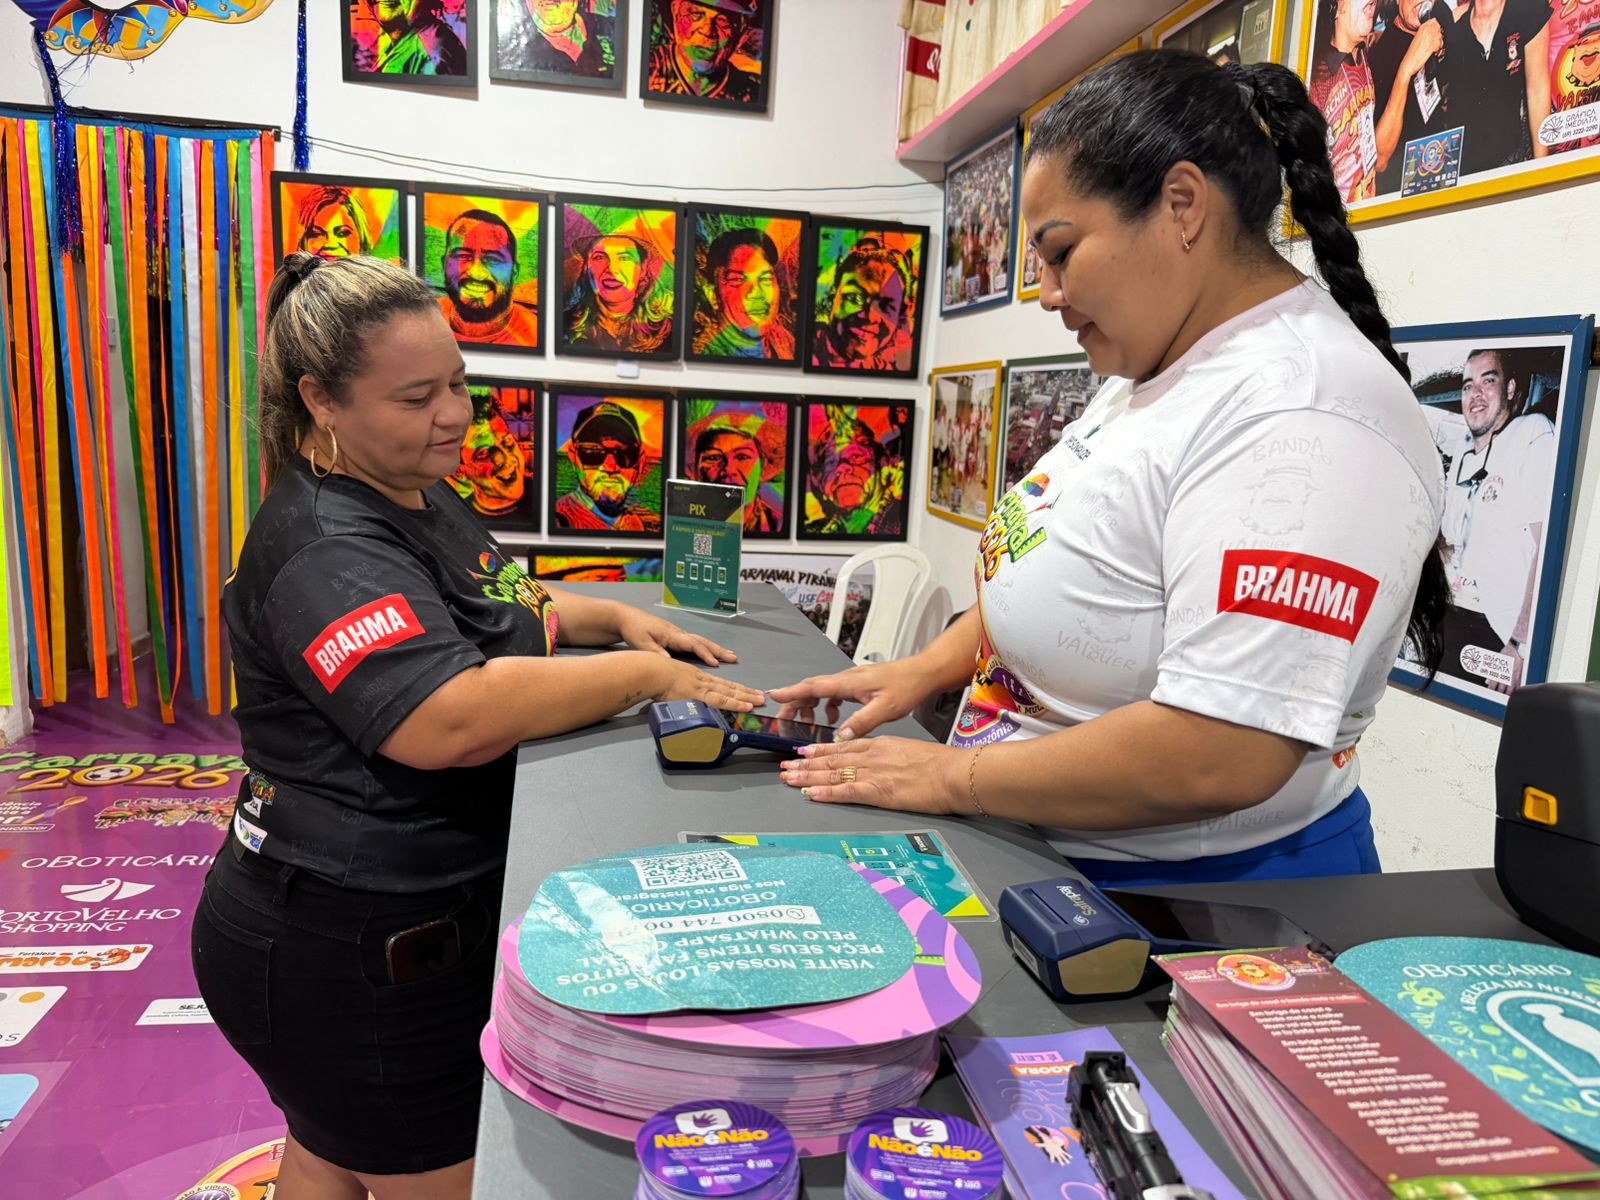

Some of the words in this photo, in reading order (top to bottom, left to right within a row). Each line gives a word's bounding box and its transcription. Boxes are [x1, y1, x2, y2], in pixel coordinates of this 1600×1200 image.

[1566, 108, 1596, 121] GRÁFICA
[1564, 116, 1598, 129] IMEDIATA
[689, 503, 707, 517] PIX
[740, 568, 795, 583] ARNAVAL
[1233, 564, 1360, 625] BRAHMA
[1165, 604, 1206, 626] ANDA
[314, 604, 409, 677] BRAHMA
[1482, 653, 1510, 668] GRÁFICA
[1482, 661, 1511, 675] IMEDIATA
[8, 764, 230, 795] 2026
[718, 884, 753, 893] siga
[755, 879, 785, 888] Nos
[692, 888, 716, 896] no
[1056, 885, 1097, 916] Safrapay
[682, 915, 722, 929] 744
[727, 908, 785, 923] 0800
[0, 921, 128, 934] SHOPPING
[674, 930, 800, 947] WHATSAPP
[802, 930, 857, 941] PELO
[695, 943, 762, 959] ITENS
[768, 943, 825, 955] SEUS
[827, 943, 885, 955] PEÇA
[706, 958, 798, 973] NOSSAS
[804, 958, 876, 970] VISITE
[624, 965, 702, 991] LOJS
[582, 982, 619, 997] OU
[1297, 1038, 1322, 1046] briga
[1015, 1065, 1073, 1075] AGORA
